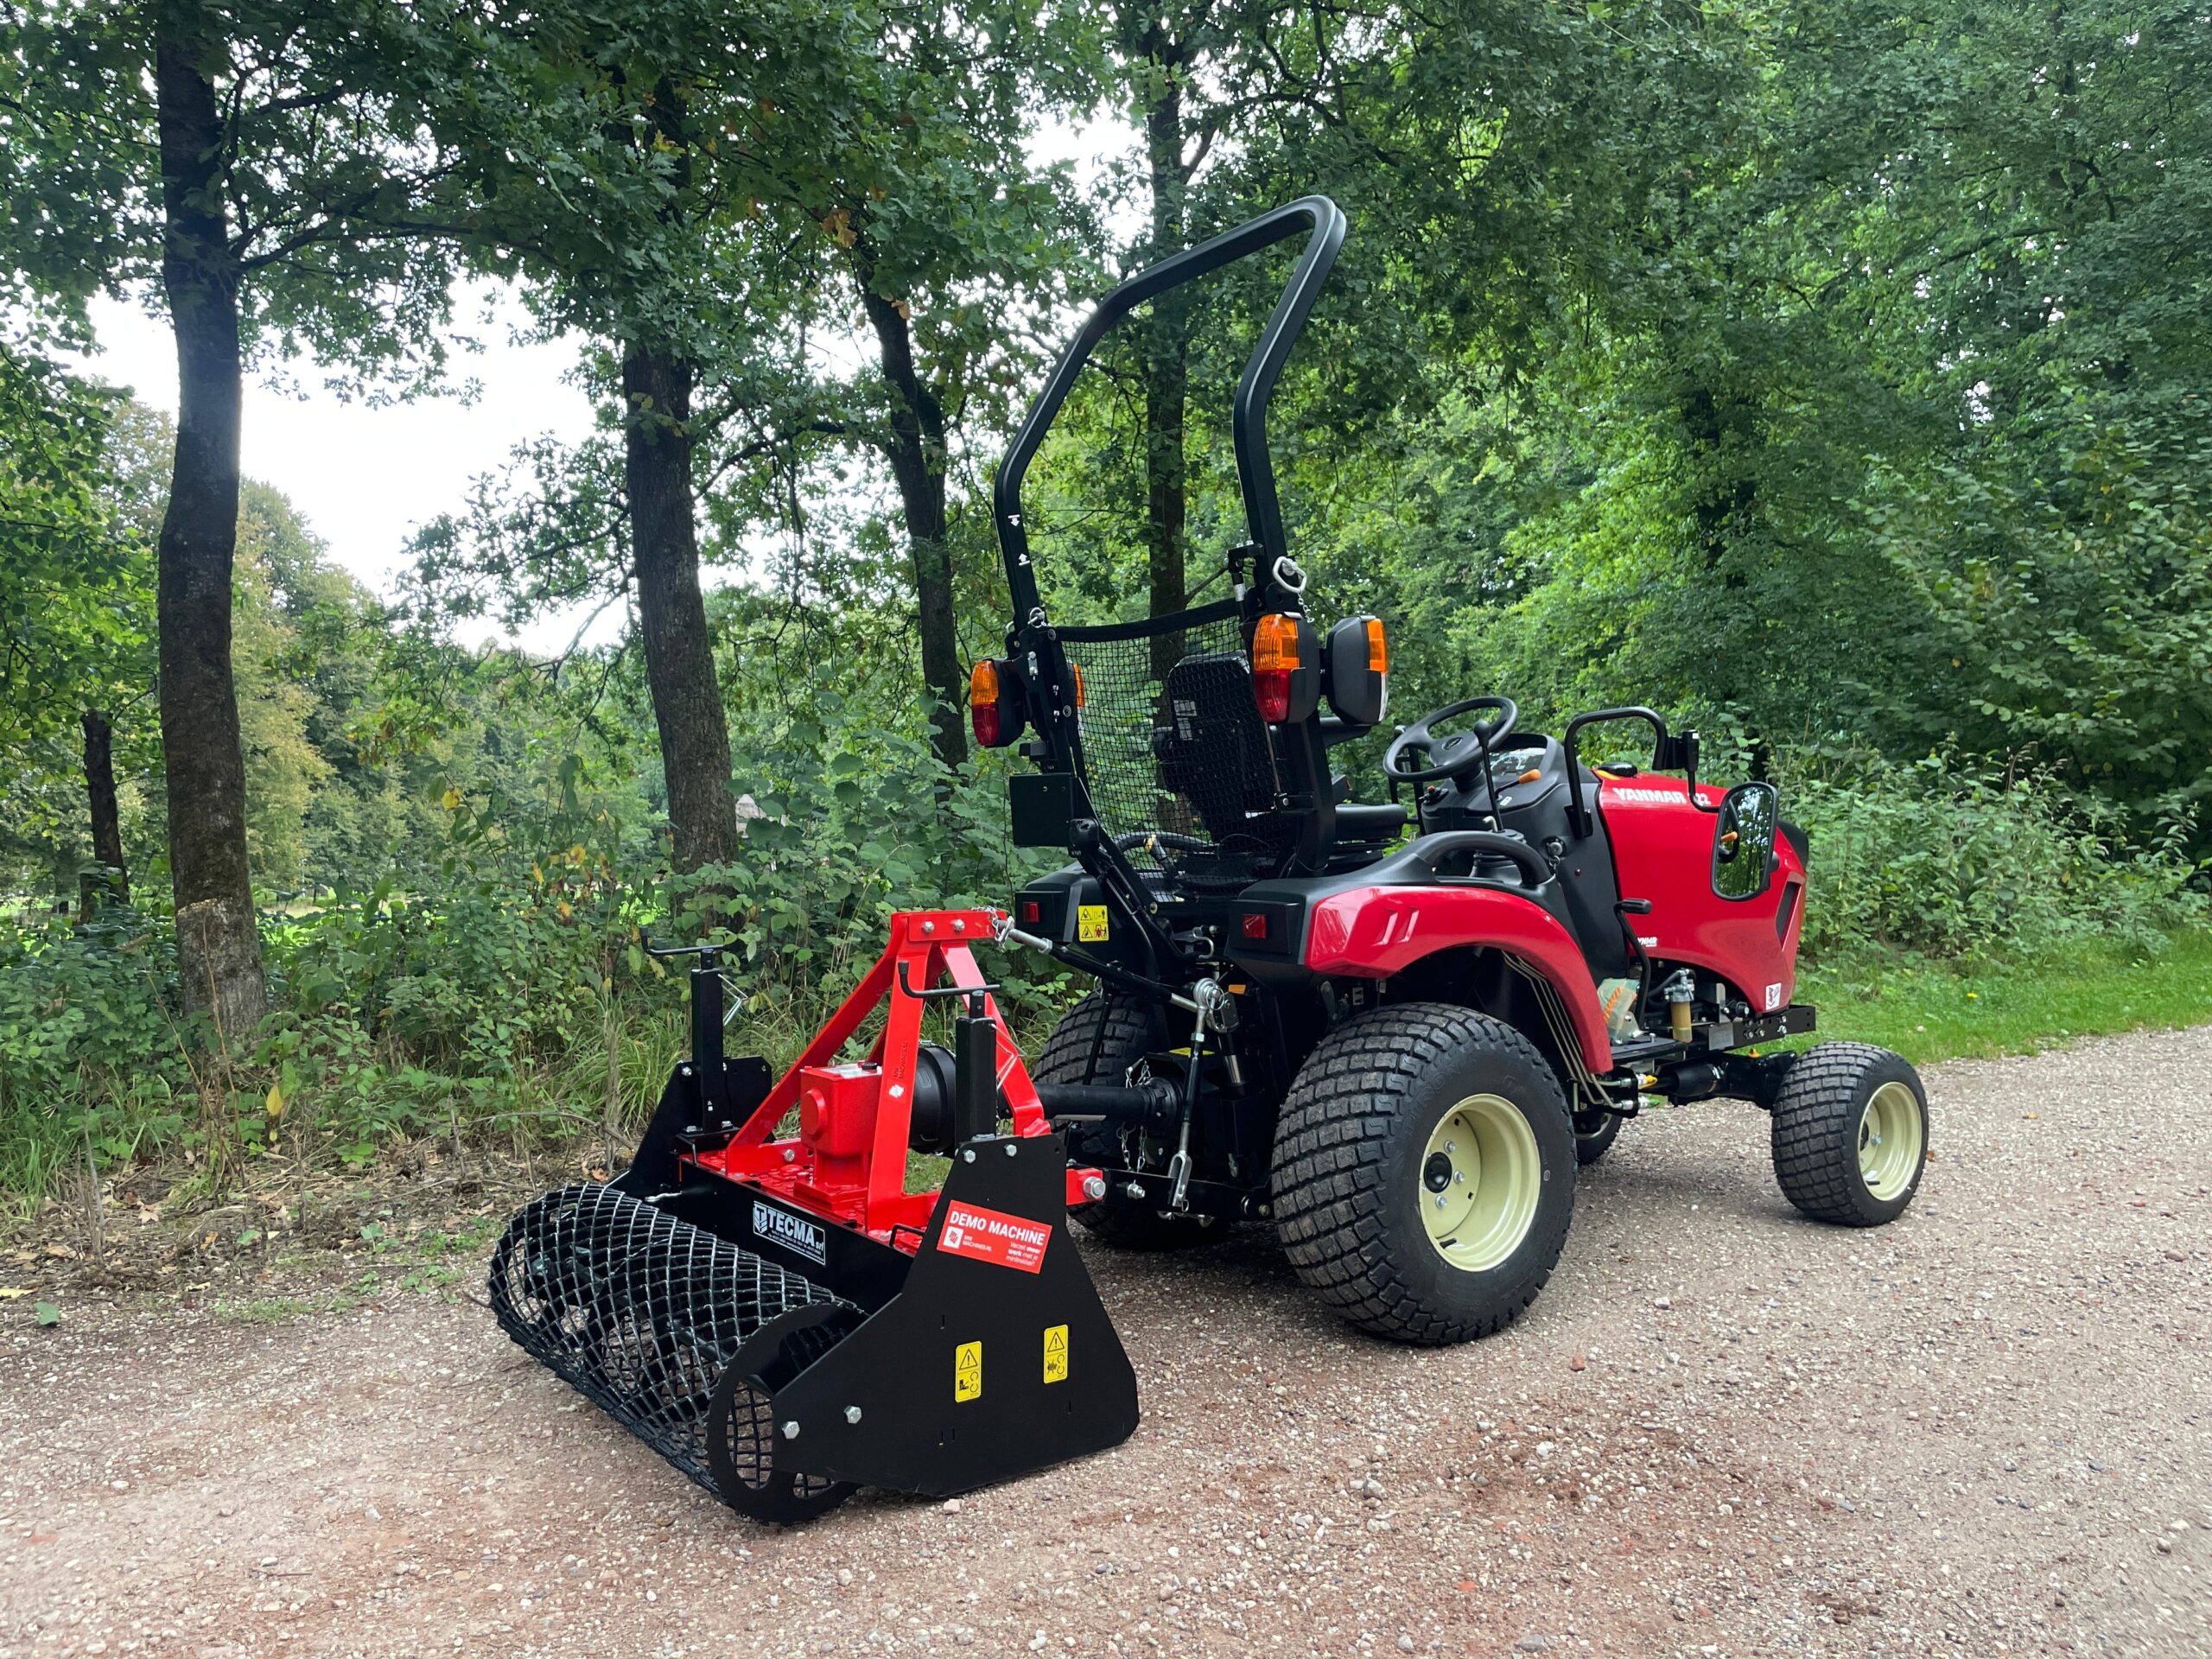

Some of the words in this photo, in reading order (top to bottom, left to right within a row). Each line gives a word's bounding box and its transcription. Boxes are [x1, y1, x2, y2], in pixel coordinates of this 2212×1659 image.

[1612, 788, 1687, 804] YANMAR
[1688, 792, 1711, 806] 22
[767, 1208, 815, 1247] TECMA
[950, 1211, 987, 1230] DEMO
[988, 1220, 1046, 1246] MACHINE
